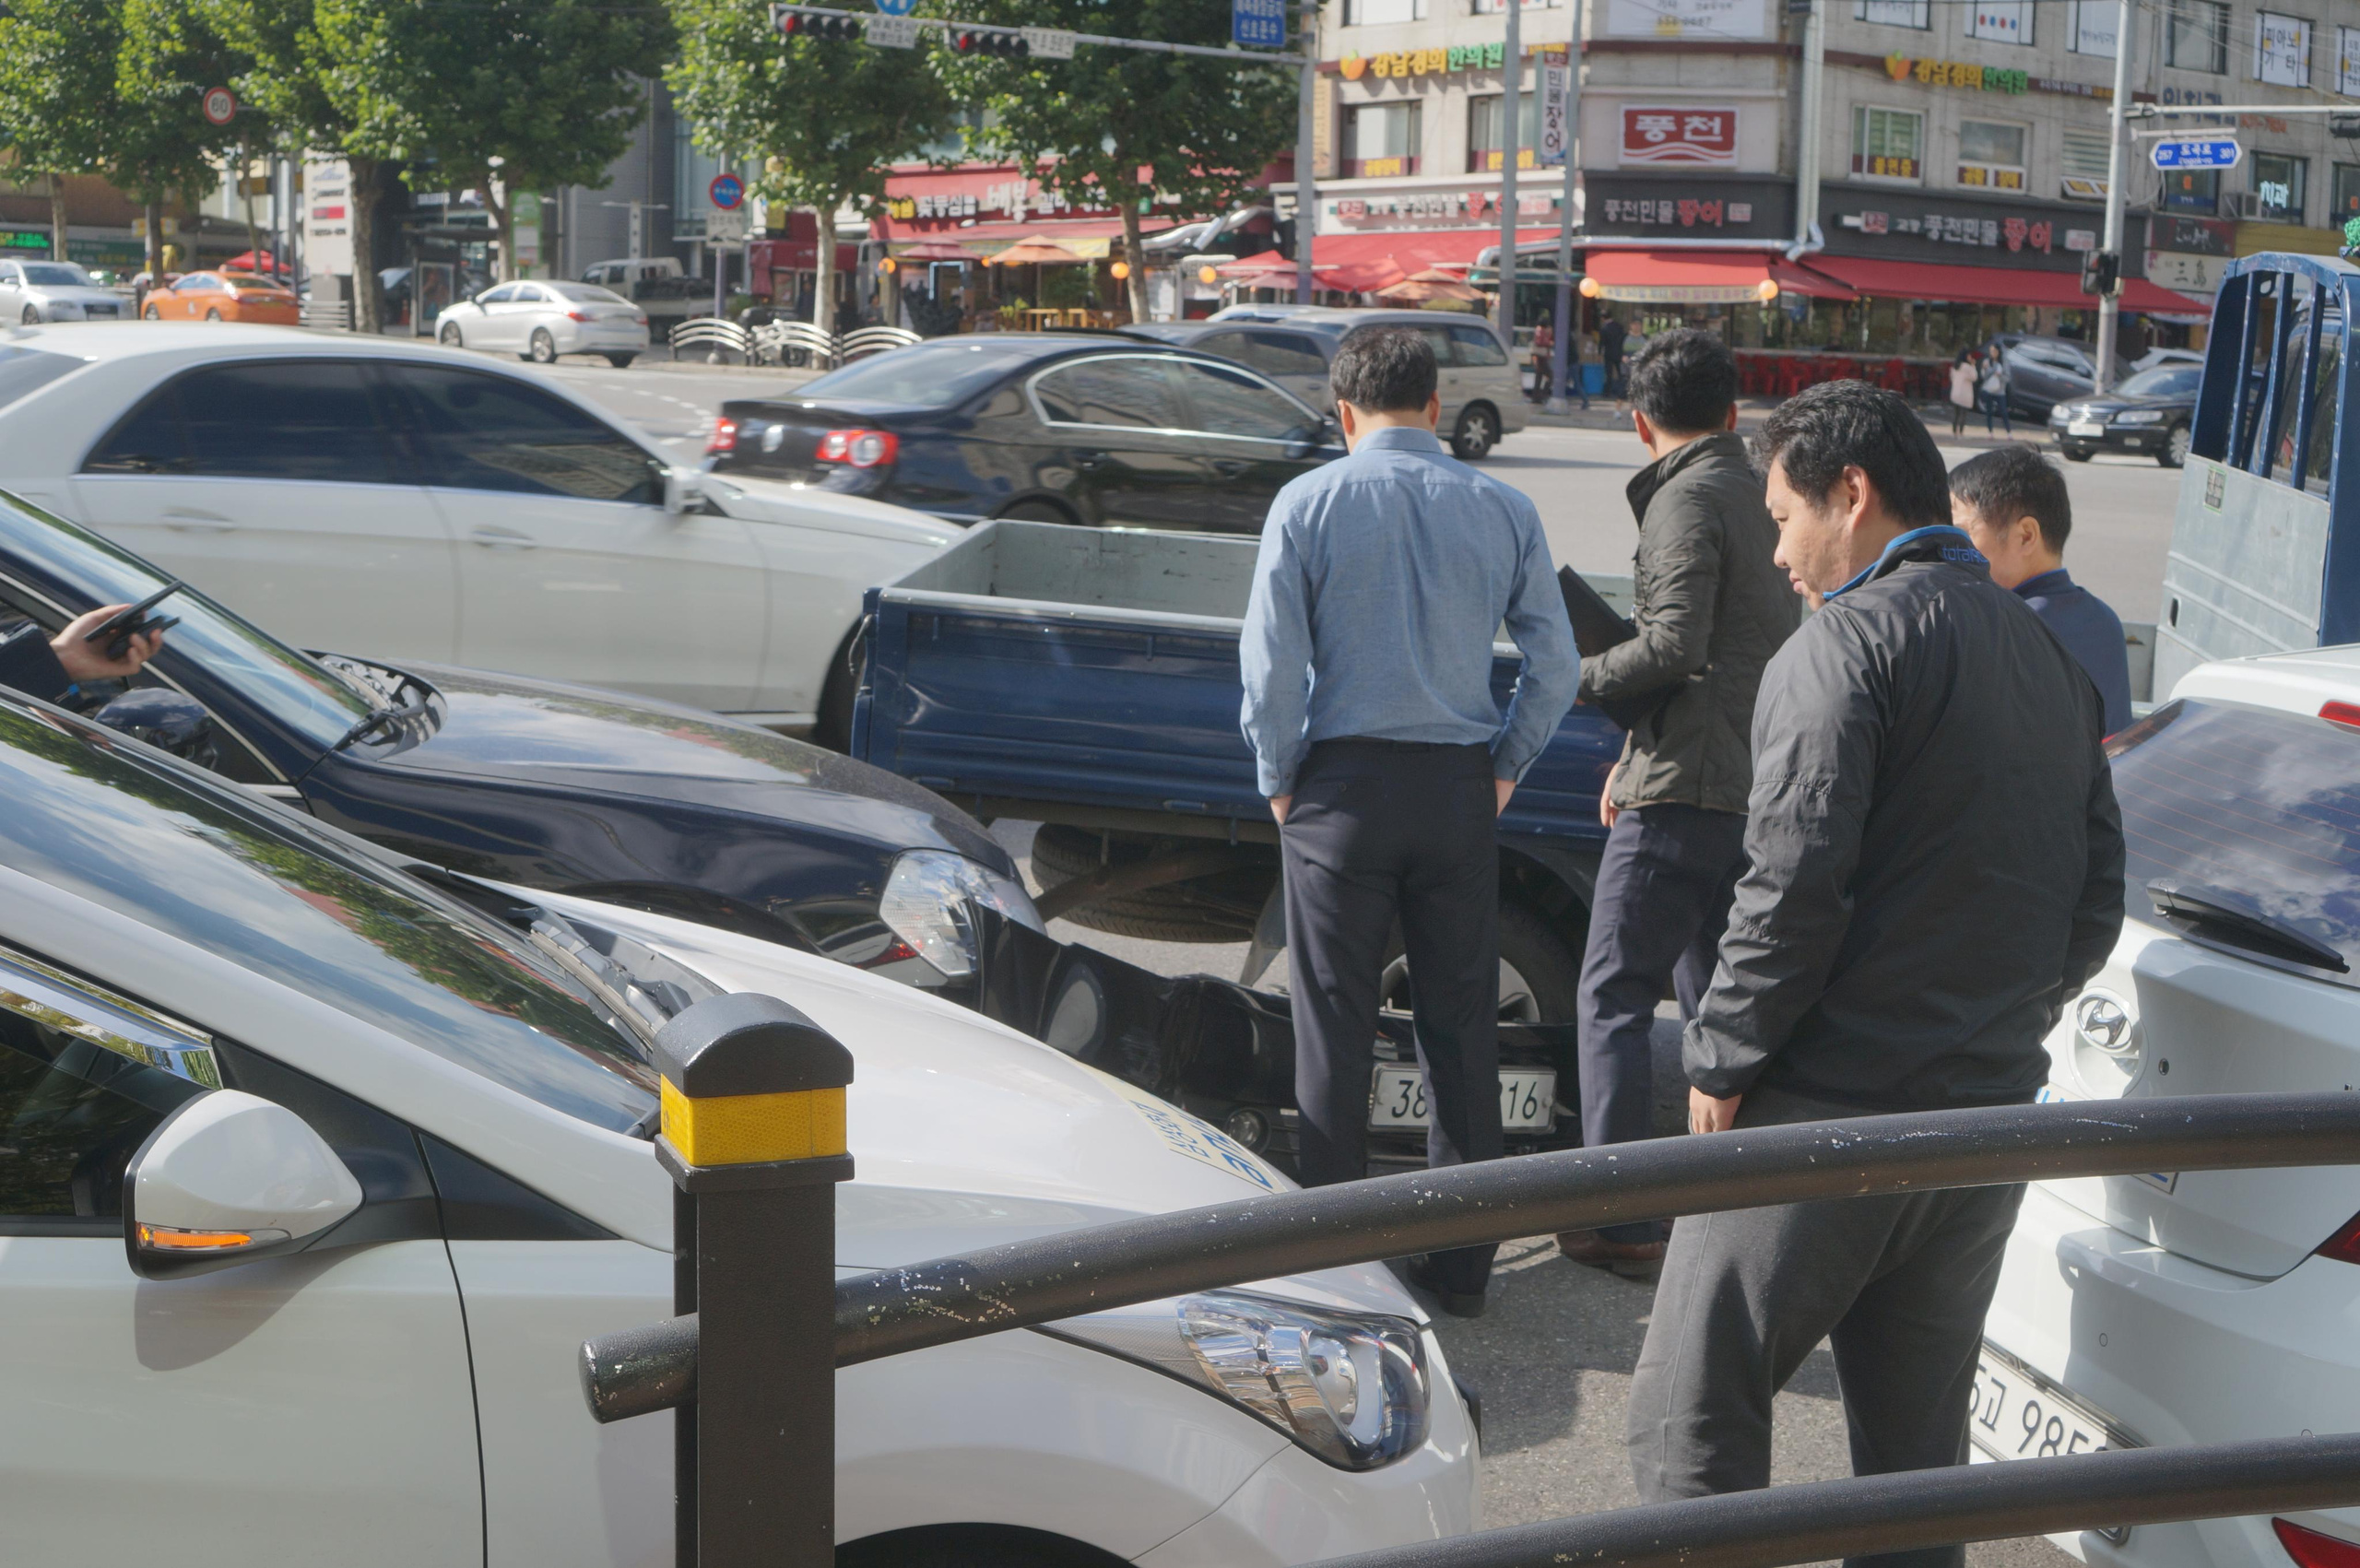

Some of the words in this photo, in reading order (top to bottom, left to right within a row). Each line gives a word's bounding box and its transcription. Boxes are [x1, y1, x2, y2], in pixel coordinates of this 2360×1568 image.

[1240, 18, 1279, 40] 신호준수
[2265, 28, 2298, 48] 피아노
[1544, 69, 1564, 153] 민물장어
[1634, 114, 1723, 142] 풍천
[2180, 144, 2212, 157] 도곡로
[1499, 1079, 1538, 1119] 16
